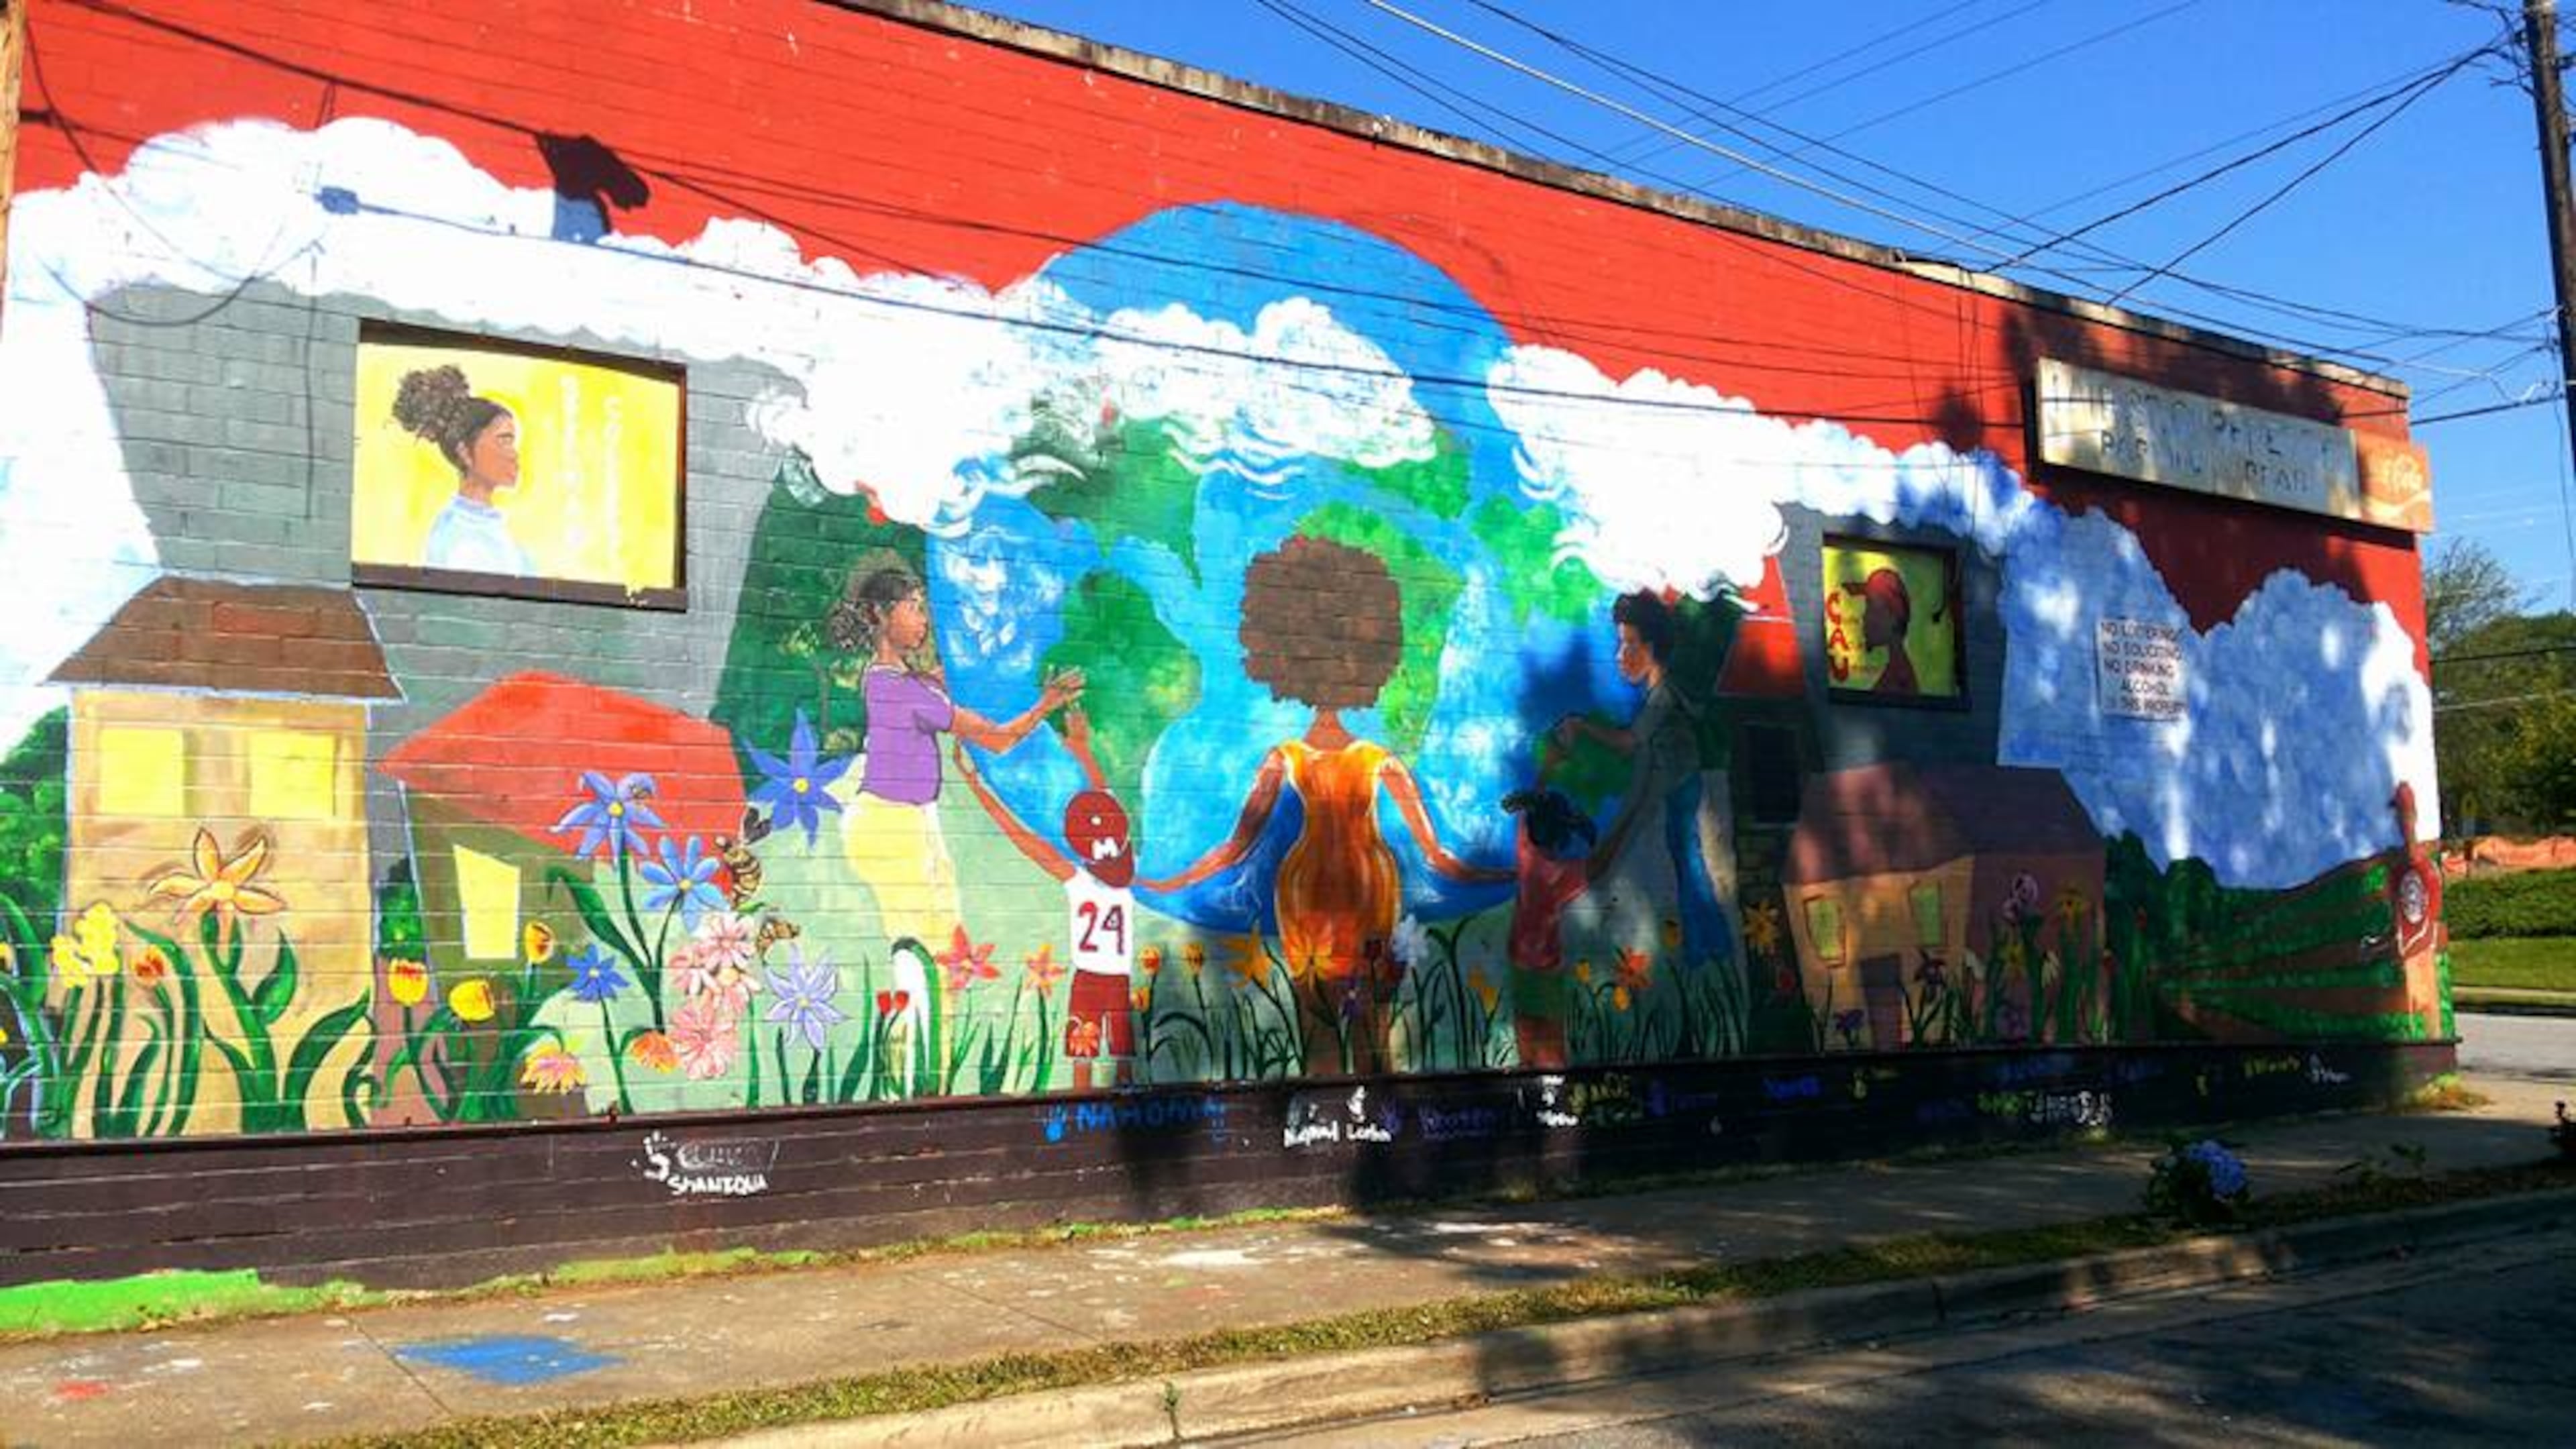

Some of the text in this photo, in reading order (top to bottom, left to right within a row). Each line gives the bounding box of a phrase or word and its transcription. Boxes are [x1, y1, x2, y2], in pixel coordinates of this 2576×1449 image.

[2104, 659, 2121, 673] NO
[1091, 836, 1120, 860] M
[1077, 900, 1125, 956] 24
